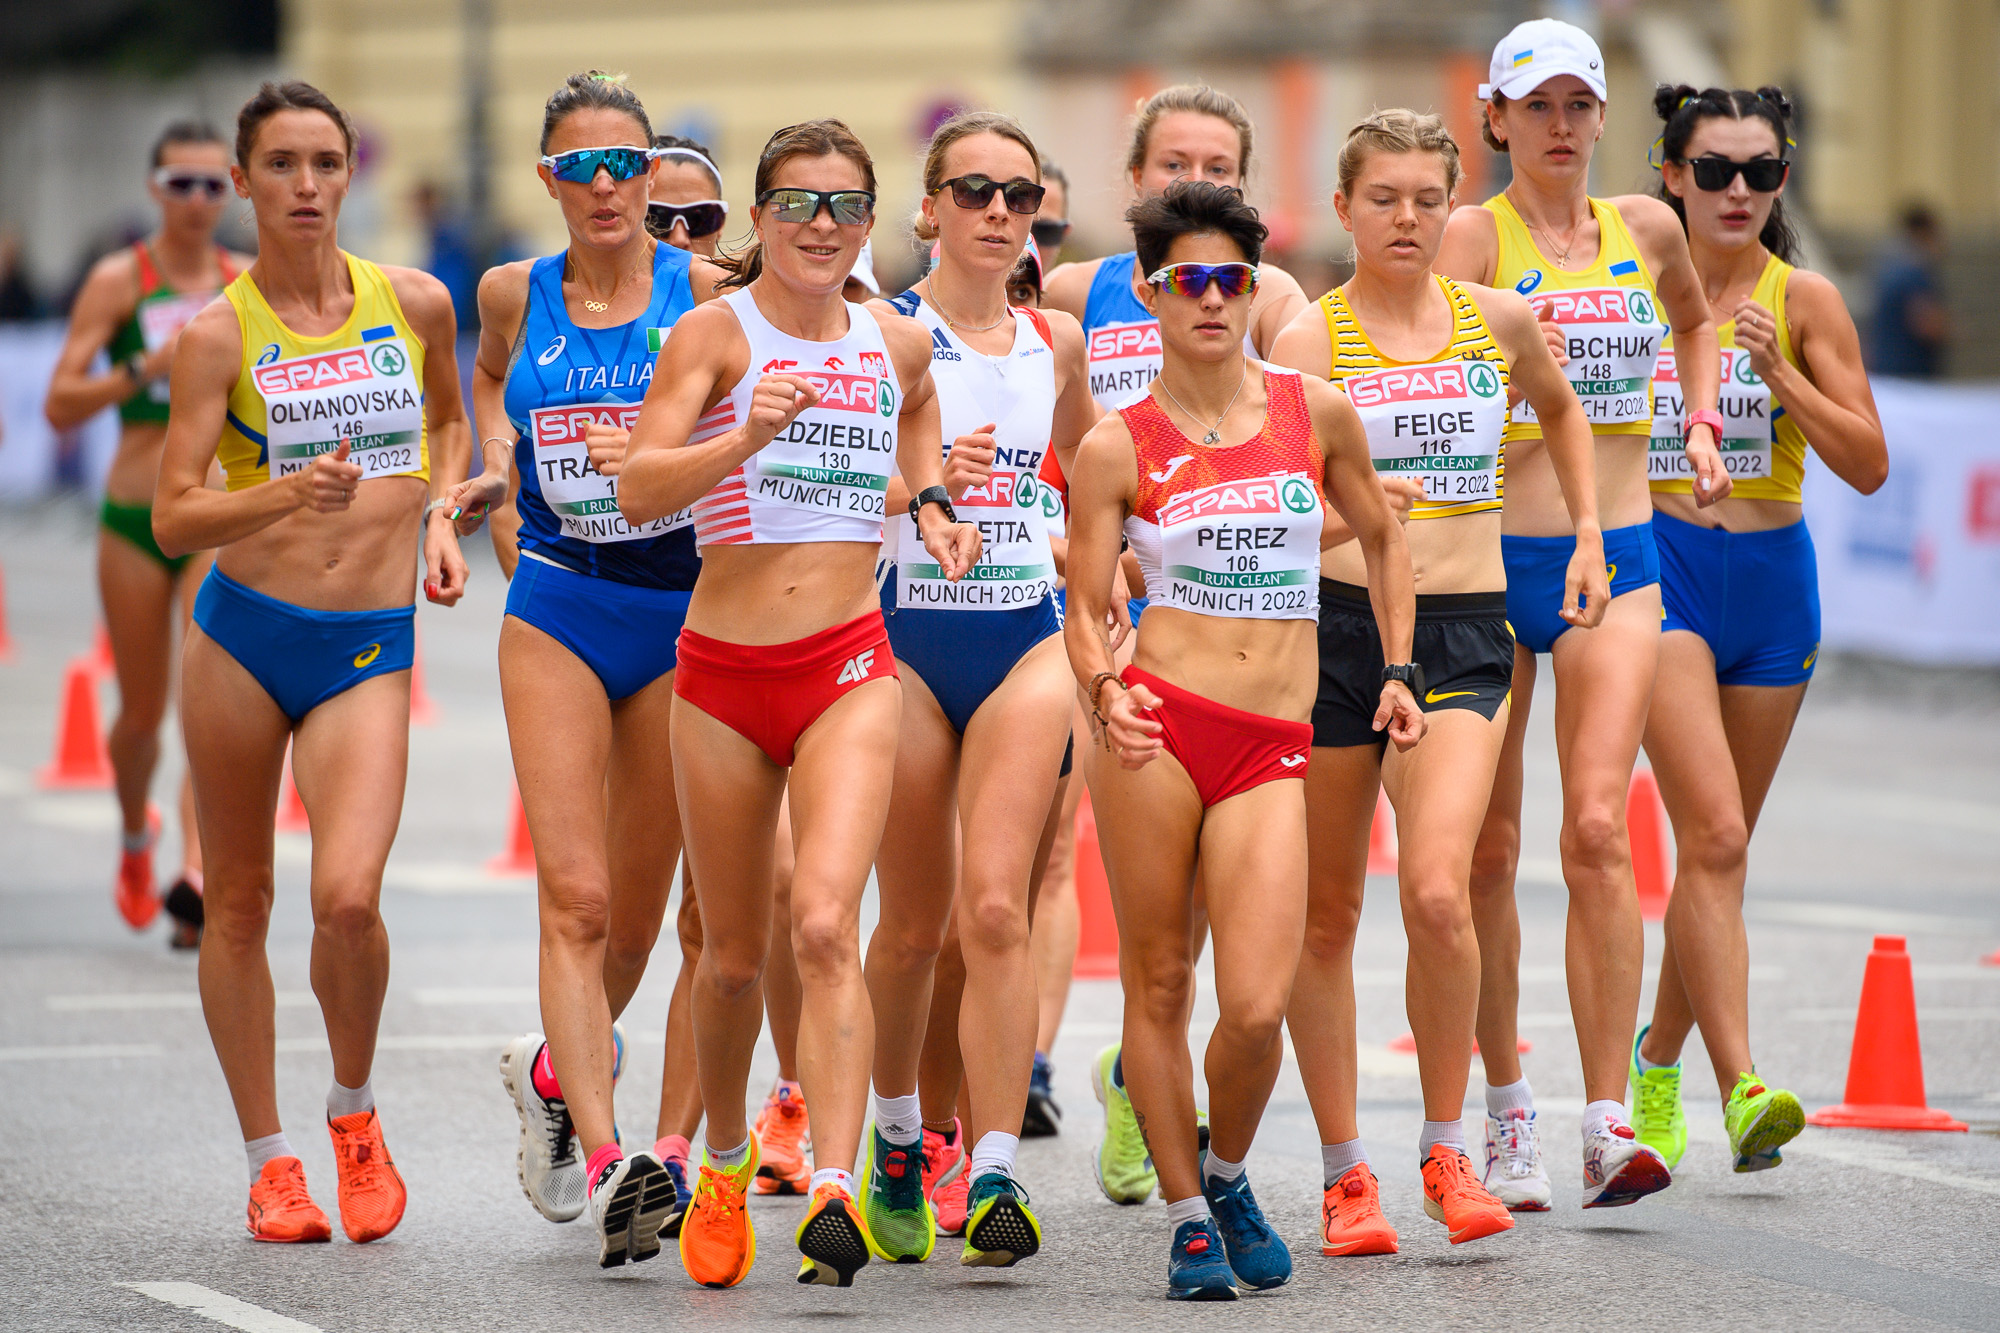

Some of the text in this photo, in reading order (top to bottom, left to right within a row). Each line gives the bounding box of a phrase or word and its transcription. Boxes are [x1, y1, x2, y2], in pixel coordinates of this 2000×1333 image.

[1092, 328, 1162, 358] SPA
[1567, 336, 1654, 360] BCHUK
[260, 354, 370, 393] SPAR
[1091, 364, 1159, 396] MARTÍ
[1581, 363, 1612, 380] 148
[804, 376, 875, 408] PAR
[1353, 370, 1463, 405] SPAR
[271, 388, 416, 424] OLYANOVSKA
[332, 420, 363, 438] 146
[773, 420, 892, 453] DZIEBLO
[1394, 411, 1475, 438] FEIGE
[1419, 439, 1452, 455] 116
[1655, 439, 1684, 450] RUN
[367, 448, 412, 472] 2022
[819, 451, 851, 470] 130
[1398, 458, 1428, 470] RUN
[1724, 455, 1762, 473] 022
[802, 468, 829, 482] RUN
[1456, 474, 1489, 494] 2022
[759, 478, 885, 516] MUNICH 202
[1197, 523, 1288, 550] PÉREZ
[1226, 555, 1259, 572] 106
[908, 580, 1048, 604] MUNICH 2022
[1205, 574, 1235, 586] RUN
[1172, 582, 1306, 611] MUNICH 2022
[836, 648, 875, 686] 4F
